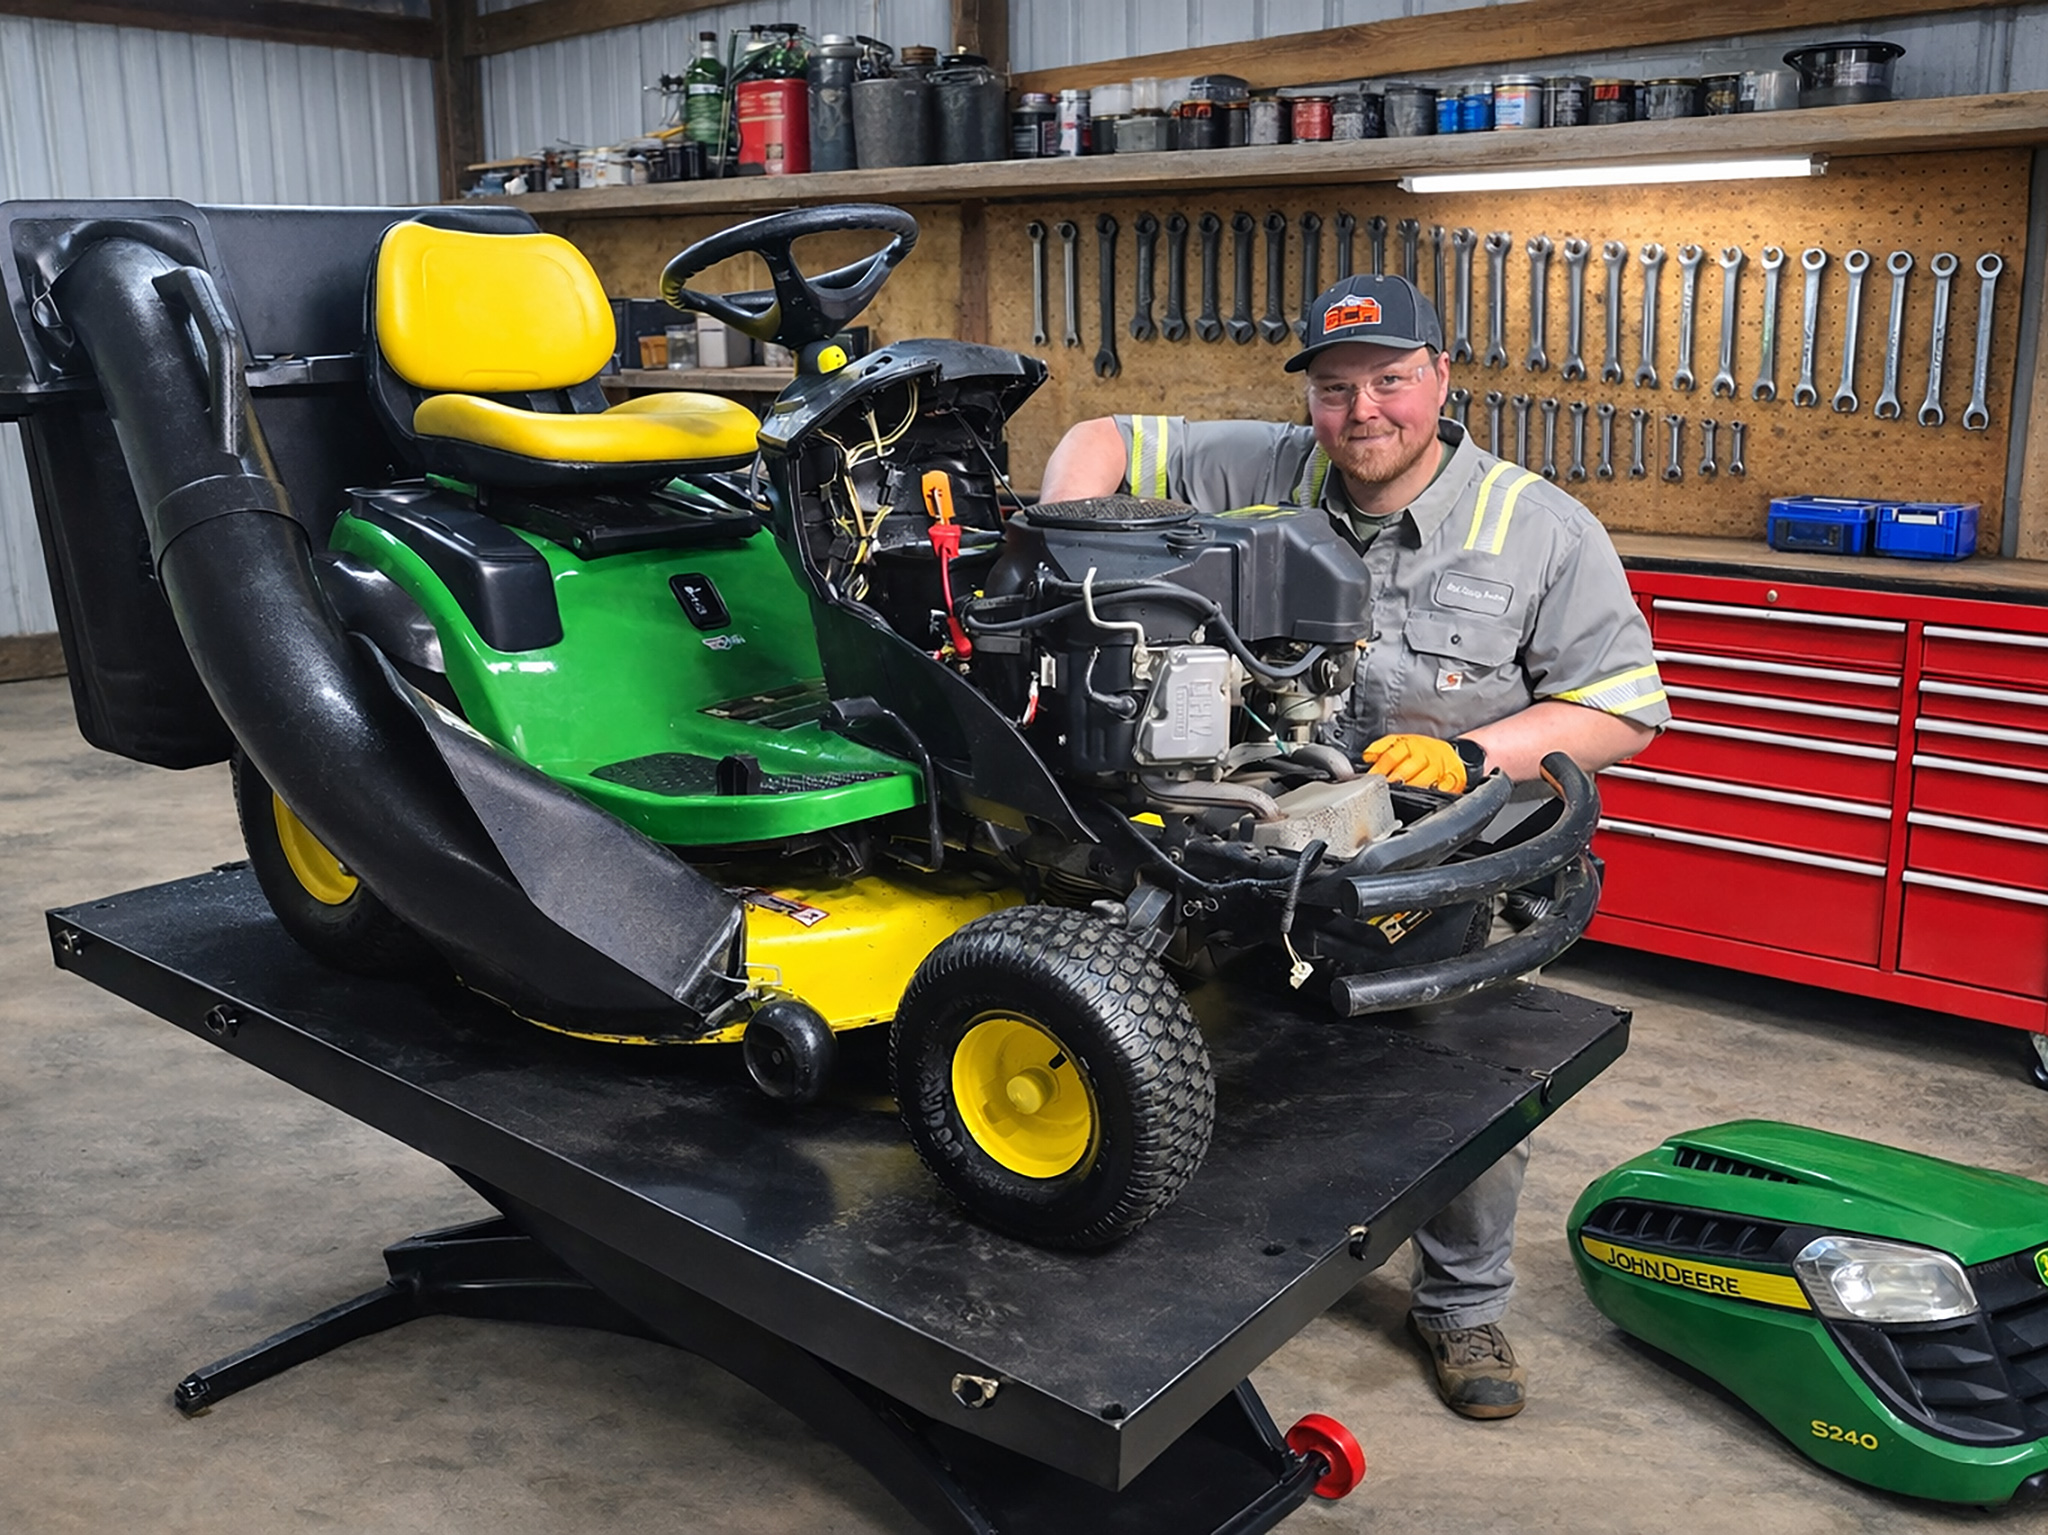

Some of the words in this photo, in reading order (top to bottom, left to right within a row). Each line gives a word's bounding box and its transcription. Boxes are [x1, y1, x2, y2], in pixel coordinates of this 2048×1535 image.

[1607, 1247, 1662, 1279] JOHN
[1662, 1261, 1742, 1295] DEERE
[1811, 1420, 1879, 1451] S240
